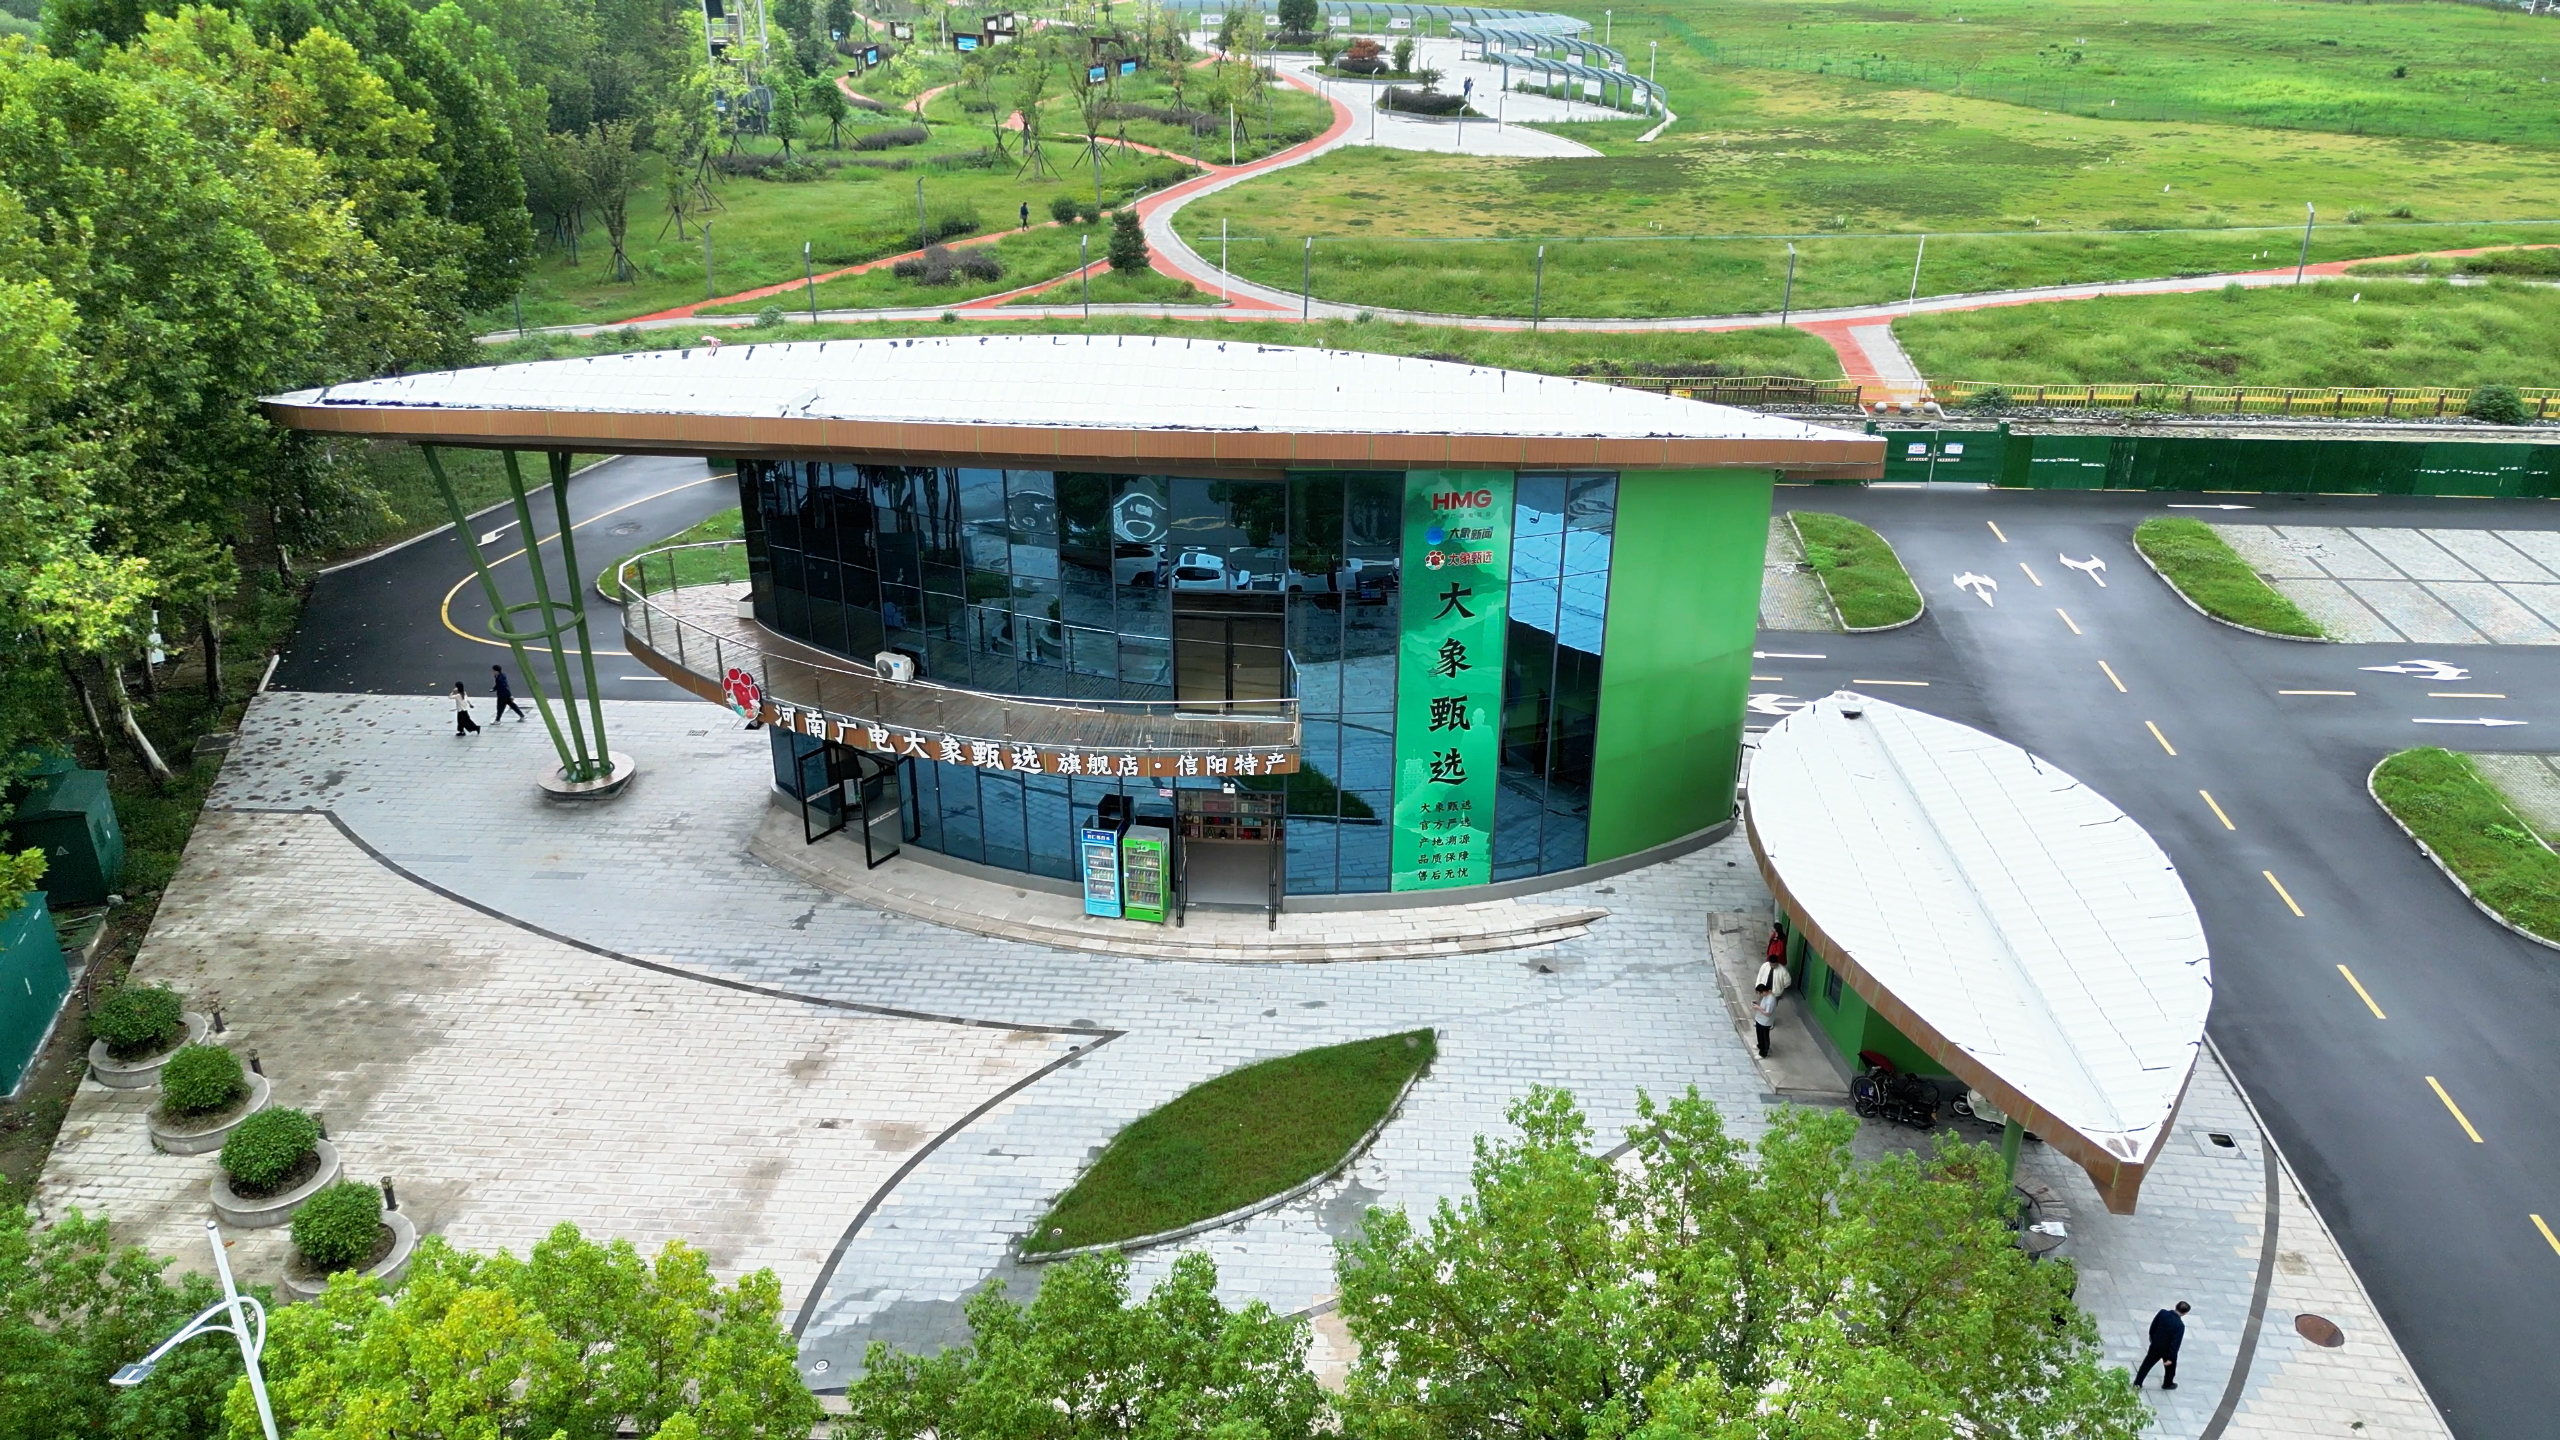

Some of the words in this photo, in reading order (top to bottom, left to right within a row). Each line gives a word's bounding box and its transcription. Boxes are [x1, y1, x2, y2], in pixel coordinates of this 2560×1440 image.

[1432, 489, 1492, 511] HMG
[1448, 526, 1493, 540] 大象新闻
[1447, 551, 1493, 566] 大象甄选
[1428, 581, 1476, 786] 大象甄选
[773, 703, 1043, 775] 河南广电大象甄选
[1420, 800, 1472, 814] 大象甄选
[1419, 817, 1471, 831] 官方严选
[1418, 834, 1471, 849] 产地溯源
[1417, 850, 1470, 865] 品质保障
[1417, 867, 1469, 881] 售后无忧
